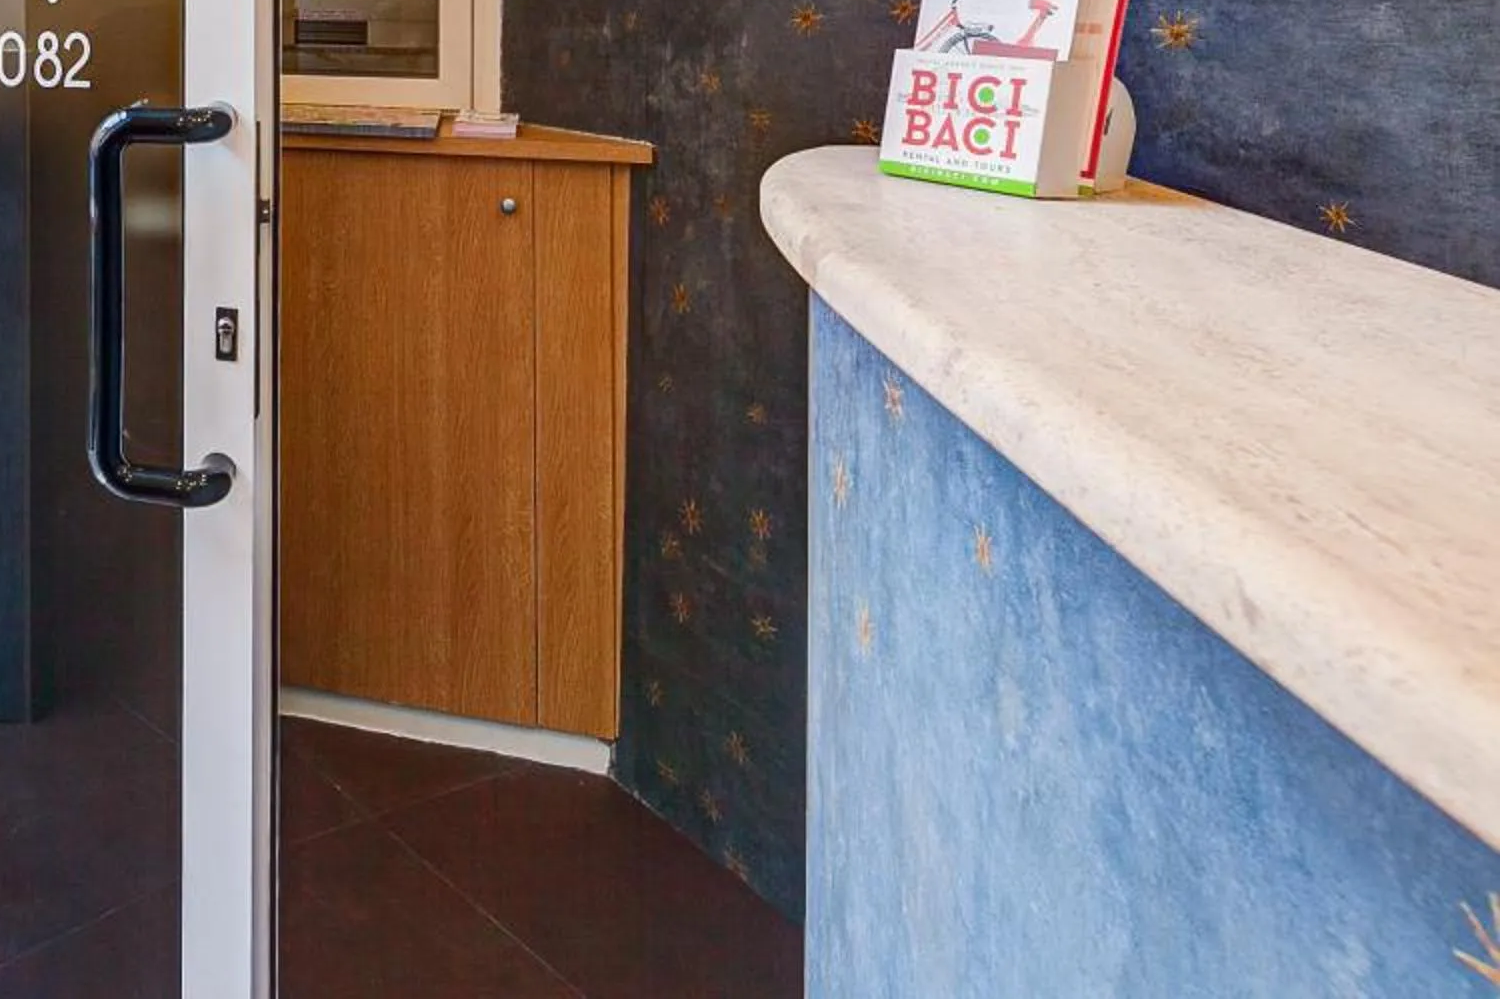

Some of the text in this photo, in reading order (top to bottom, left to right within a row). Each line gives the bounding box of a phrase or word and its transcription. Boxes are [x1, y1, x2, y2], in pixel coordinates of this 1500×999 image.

[33, 30, 92, 88] 82
[907, 69, 1027, 117] BICI
[902, 108, 1020, 159] BACI
